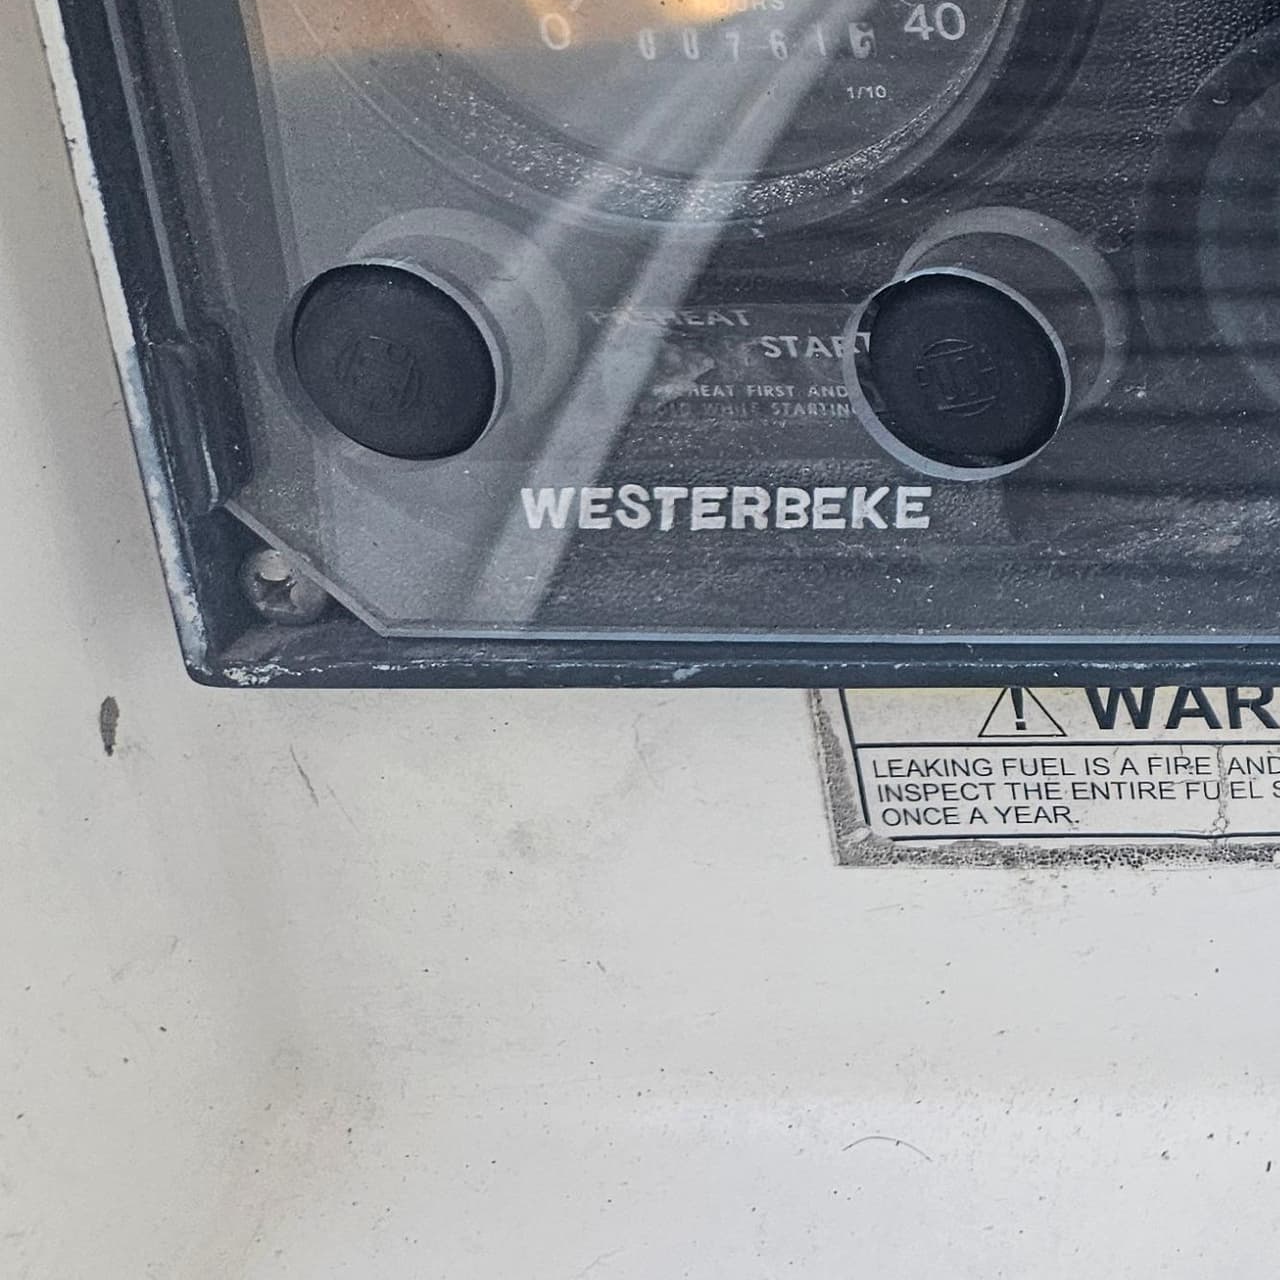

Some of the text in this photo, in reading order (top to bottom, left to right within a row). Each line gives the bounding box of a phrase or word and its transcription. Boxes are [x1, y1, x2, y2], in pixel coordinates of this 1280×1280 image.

[539, 12, 571, 50] 0
[903, 2, 967, 41] 40
[846, 84, 888, 101] 1/10
[746, 385, 795, 398] FIRST
[808, 385, 849, 398] AND
[521, 485, 933, 531] WESTERBEKE
[872, 758, 993, 778] LEAKING
[1002, 757, 1075, 777] FUEL
[1085, 757, 1110, 776] IS
[1119, 757, 1140, 776] A
[1148, 756, 1212, 776] FIRE
[877, 782, 996, 803] INSPECT
[1003, 782, 1069, 801] THE
[1072, 782, 1176, 801] ENTIRE
[1186, 780, 1264, 800] FUEL
[881, 805, 1080, 827] ONCE A YEAR.
